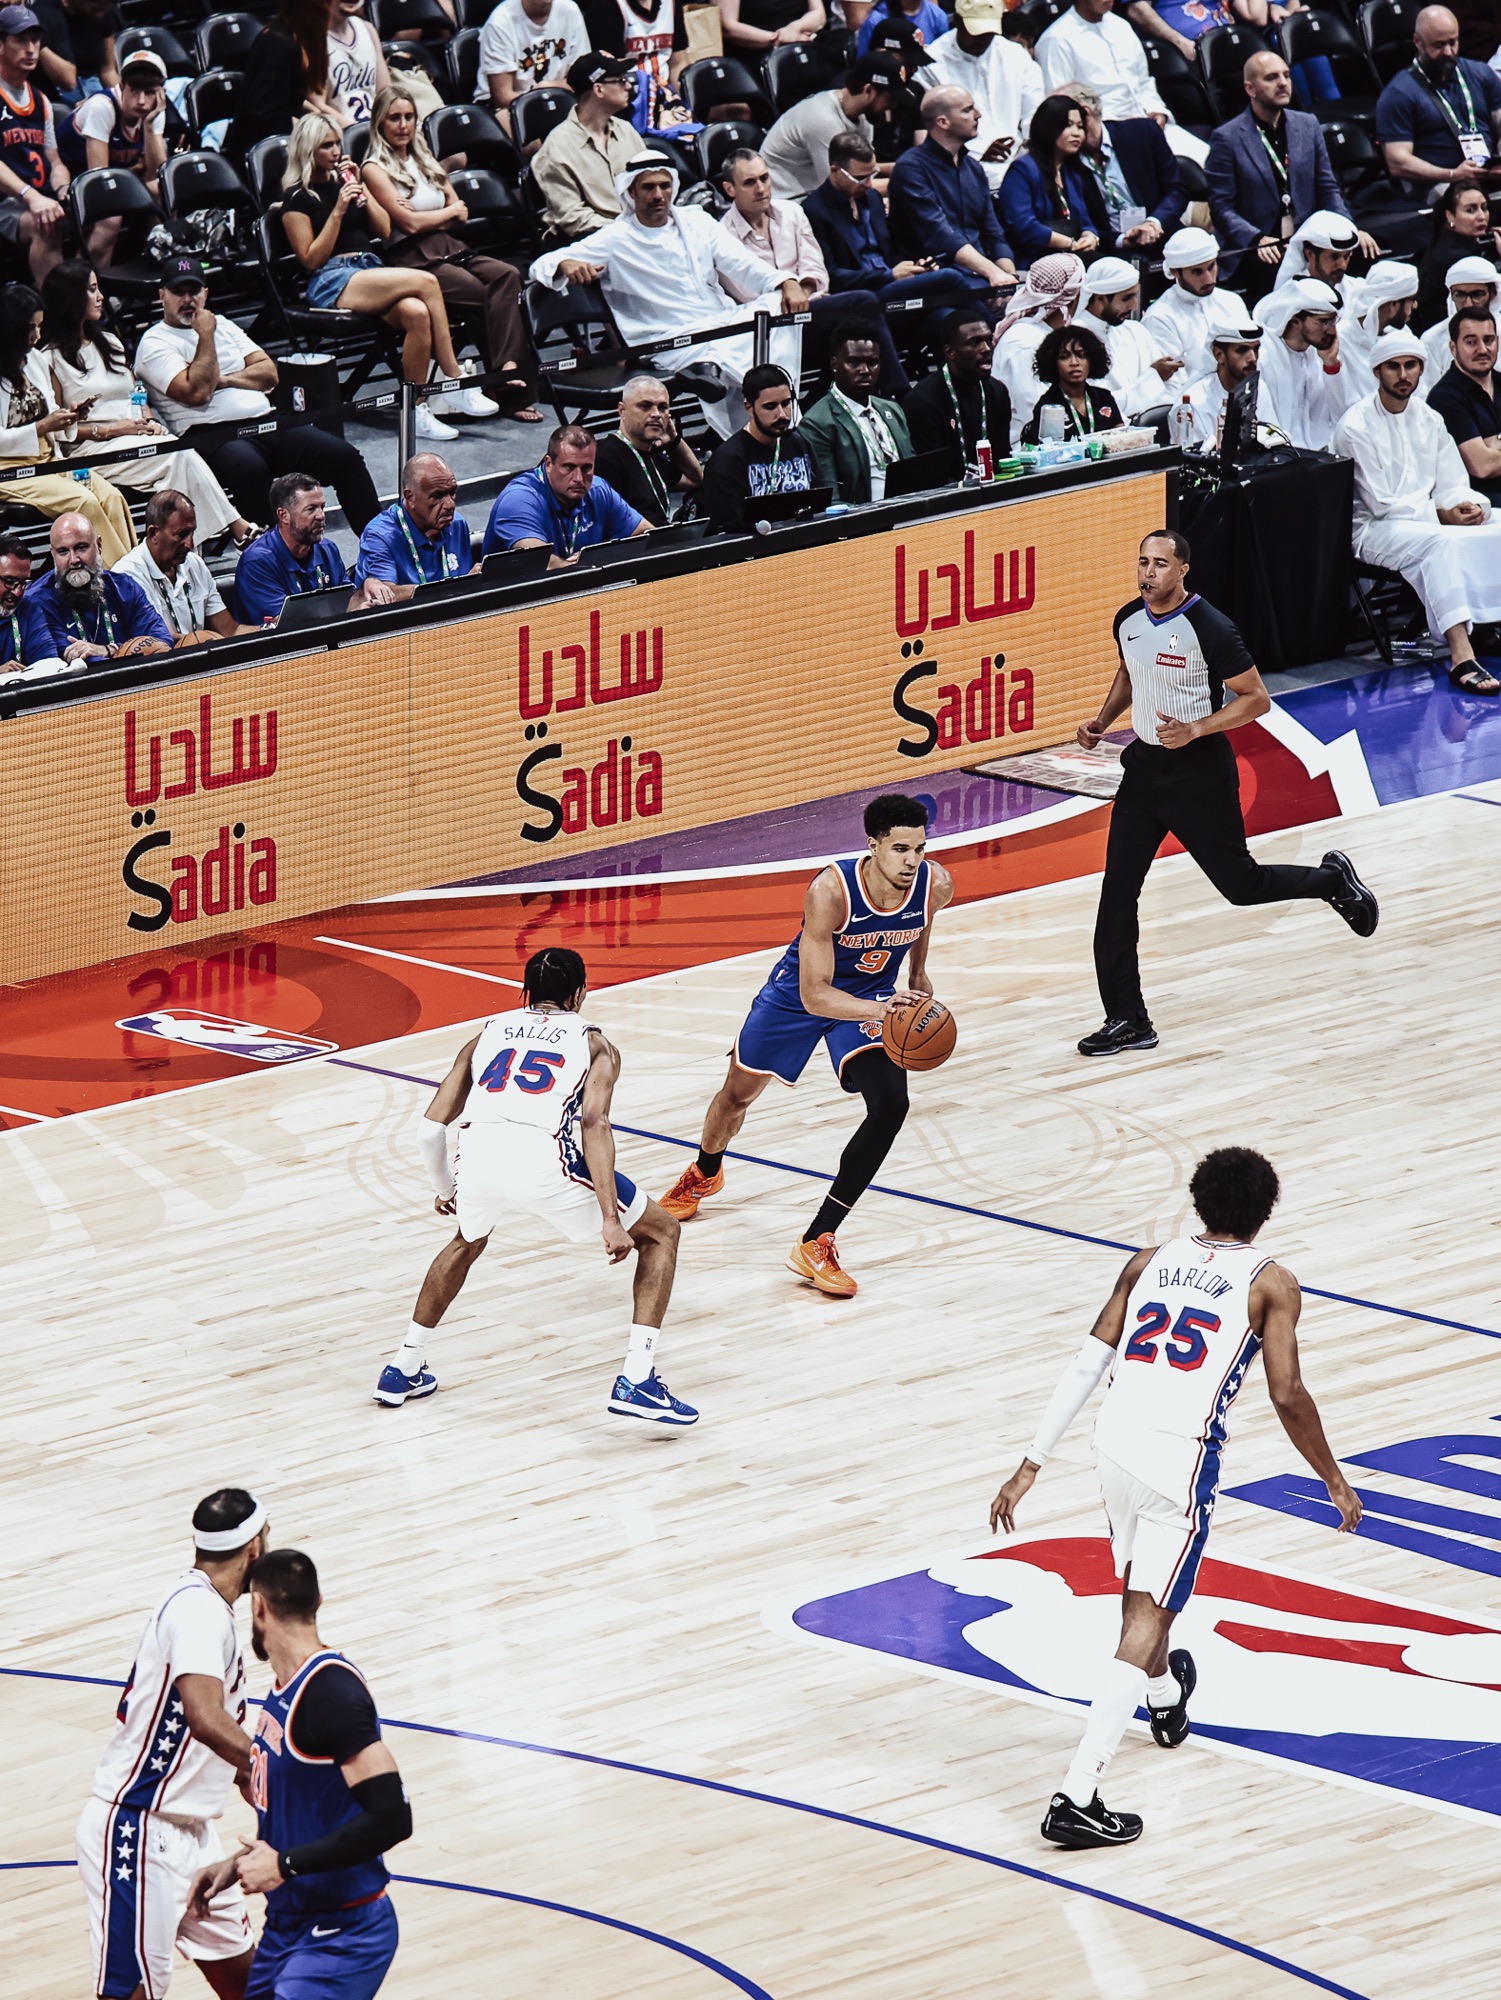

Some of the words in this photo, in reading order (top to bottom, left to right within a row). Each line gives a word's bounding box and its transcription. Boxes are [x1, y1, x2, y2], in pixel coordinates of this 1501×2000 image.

[28, 151, 45, 188] 3
[178, 260, 191, 271] NY
[675, 338, 691, 346] ARENA
[444, 382, 459, 390] ARENA
[378, 396, 394, 404] ARENA
[260, 422, 277, 432] ARENA
[140, 448, 156, 456] ARENA
[18, 468, 34, 476] ARENA
[895, 530, 1035, 658] ساديا
[1157, 655, 1185, 666] Emirates
[519, 610, 663, 741] ساديا
[893, 653, 1035, 758] Sadia
[124, 694, 277, 828] ساديا
[516, 736, 663, 843] Sadia
[122, 823, 277, 932] Sadia
[838, 931, 881, 949] NEW
[882, 927, 924, 947] YORK
[854, 949, 892, 975] 9
[504, 1026, 567, 1044] SALLIS
[249, 1045, 306, 1059] NBA
[478, 1047, 566, 1095] 45
[1158, 1267, 1234, 1300] BARLOW
[1124, 1301, 1222, 1372] 25
